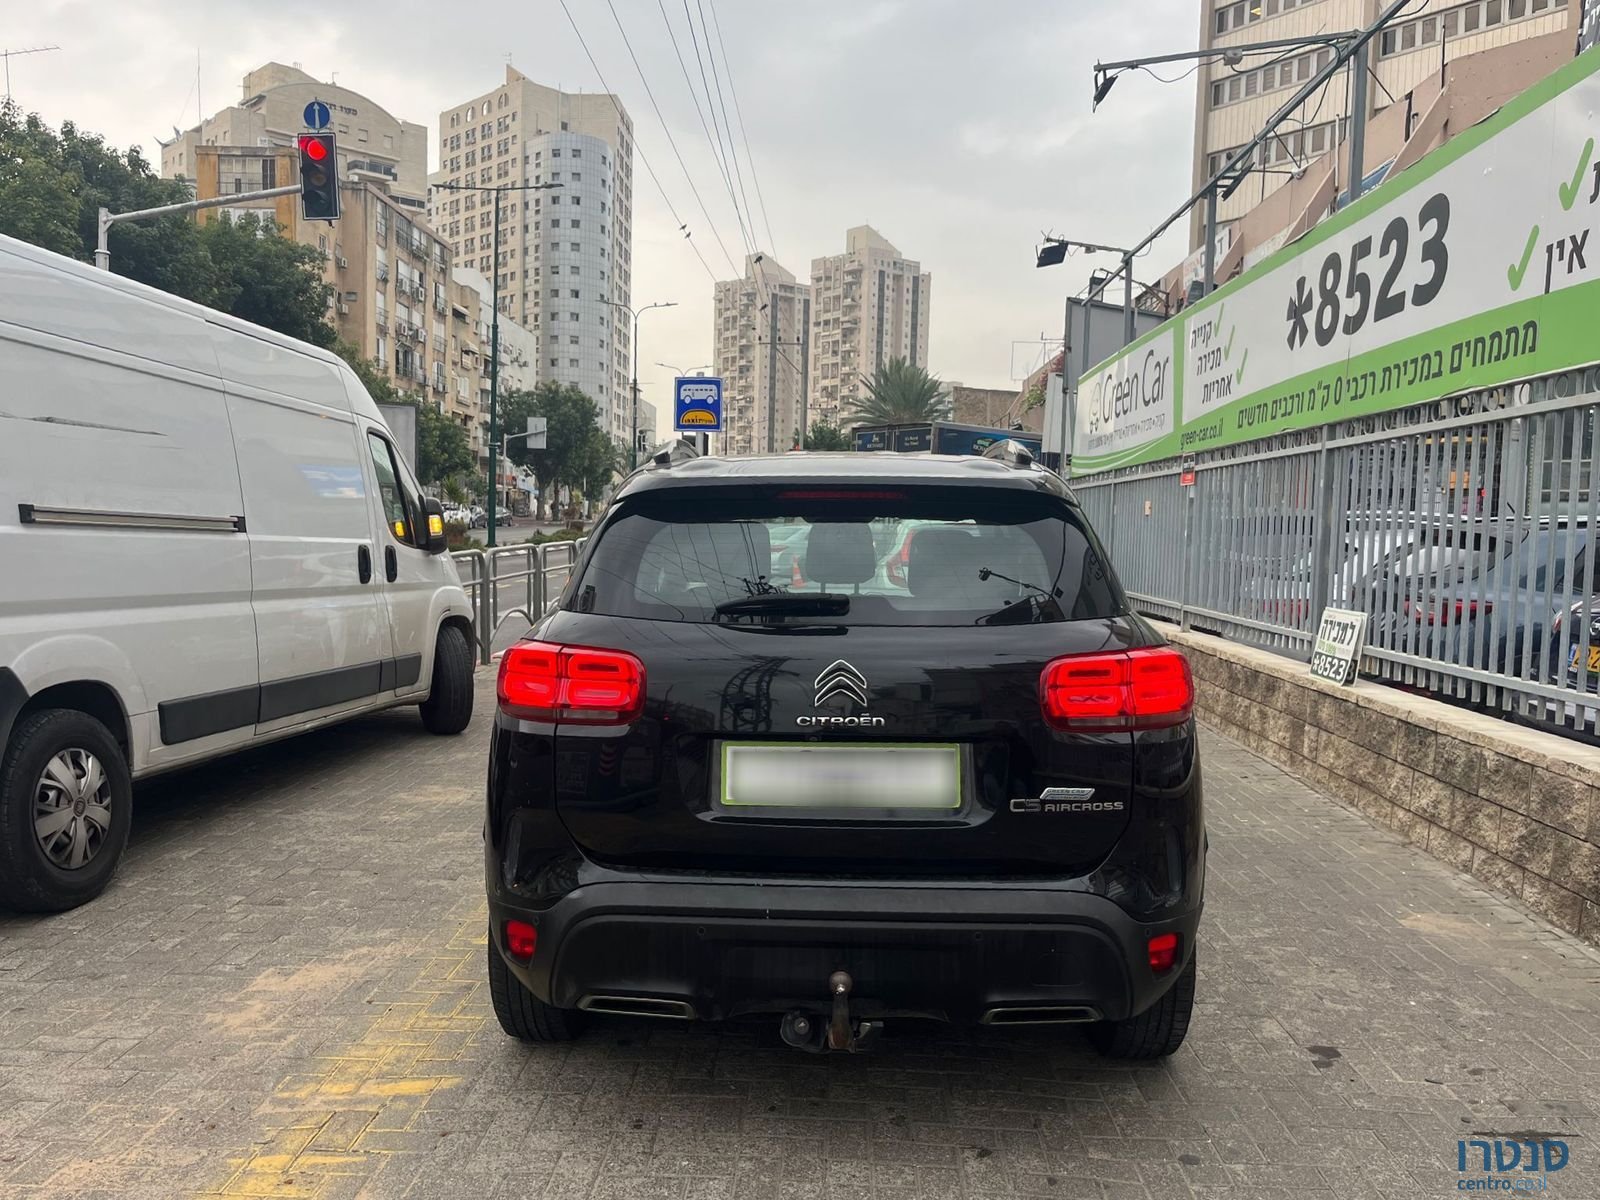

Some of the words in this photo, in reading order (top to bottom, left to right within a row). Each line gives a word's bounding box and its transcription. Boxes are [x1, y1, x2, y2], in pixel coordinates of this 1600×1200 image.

[1544, 229, 1590, 295] אין
[1190, 321, 1212, 349] קנייה
[1449, 320, 1538, 374] מתמחים
[1197, 347, 1222, 376] מכירה
[1379, 350, 1443, 393] במכירת
[1103, 373, 1139, 424] Green
[1142, 349, 1169, 407] Car
[1202, 374, 1233, 404] אחריות
[1346, 371, 1376, 401] רכבי
[1237, 402, 1268, 429] חדשים
[1270, 392, 1305, 421] ורכבים
[1180, 417, 1224, 450] green-car.co.il
[1320, 619, 1356, 646] למכירה
[1010, 799, 1041, 812] C5
[1044, 801, 1124, 812] AIRCROSS
